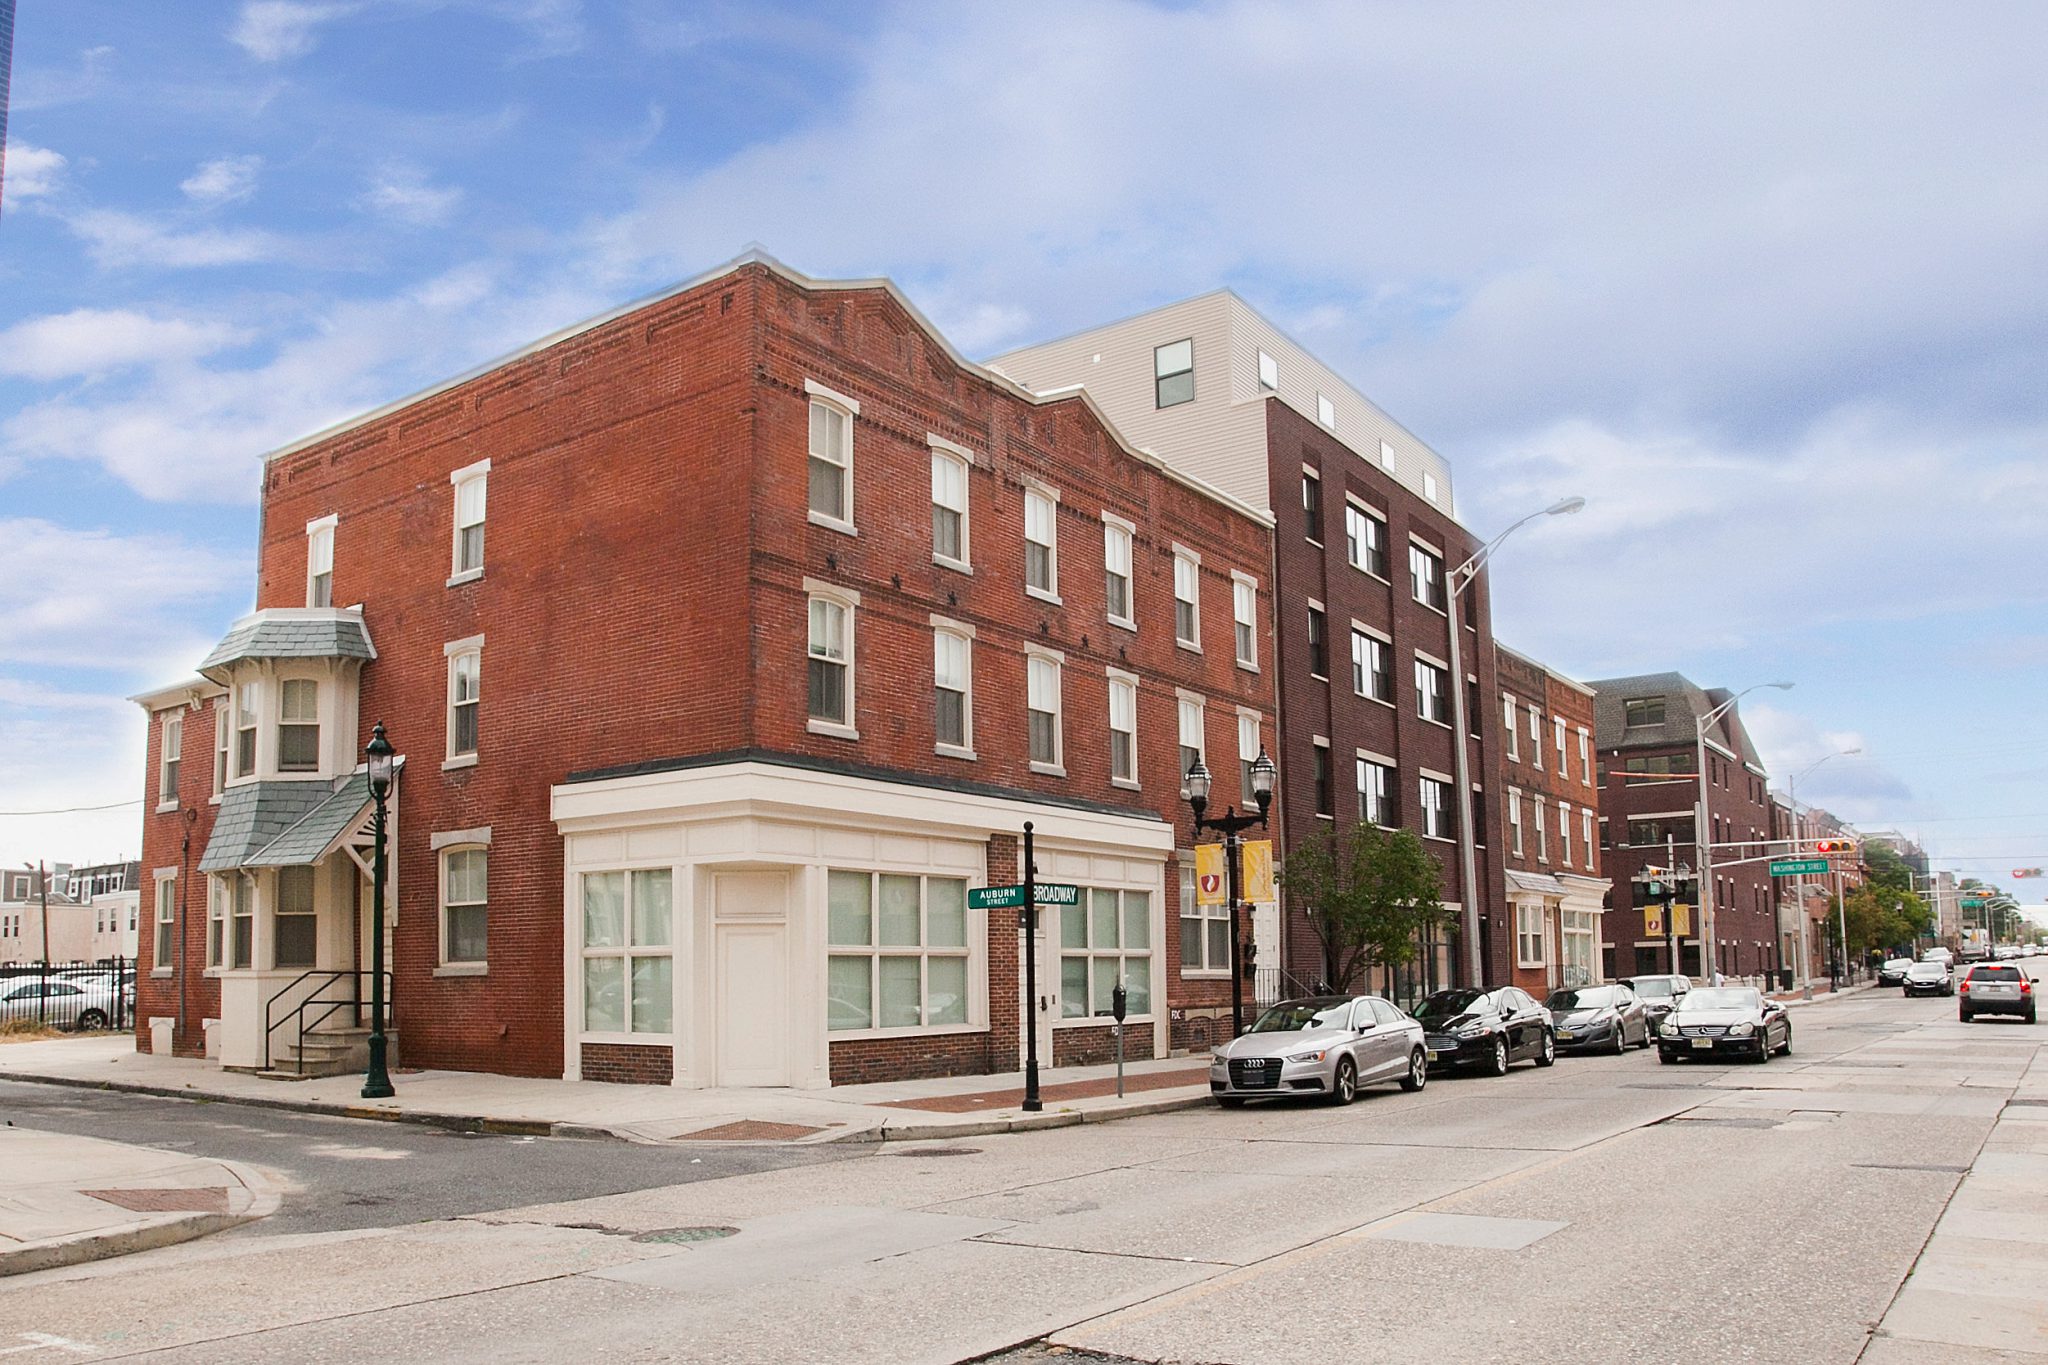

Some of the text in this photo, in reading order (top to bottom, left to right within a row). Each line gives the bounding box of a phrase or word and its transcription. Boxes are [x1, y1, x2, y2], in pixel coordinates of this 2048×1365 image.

[980, 889, 1016, 899] AUBURN
[1033, 885, 1076, 902] BROADWAY
[1111, 1026, 1119, 1036] FD
